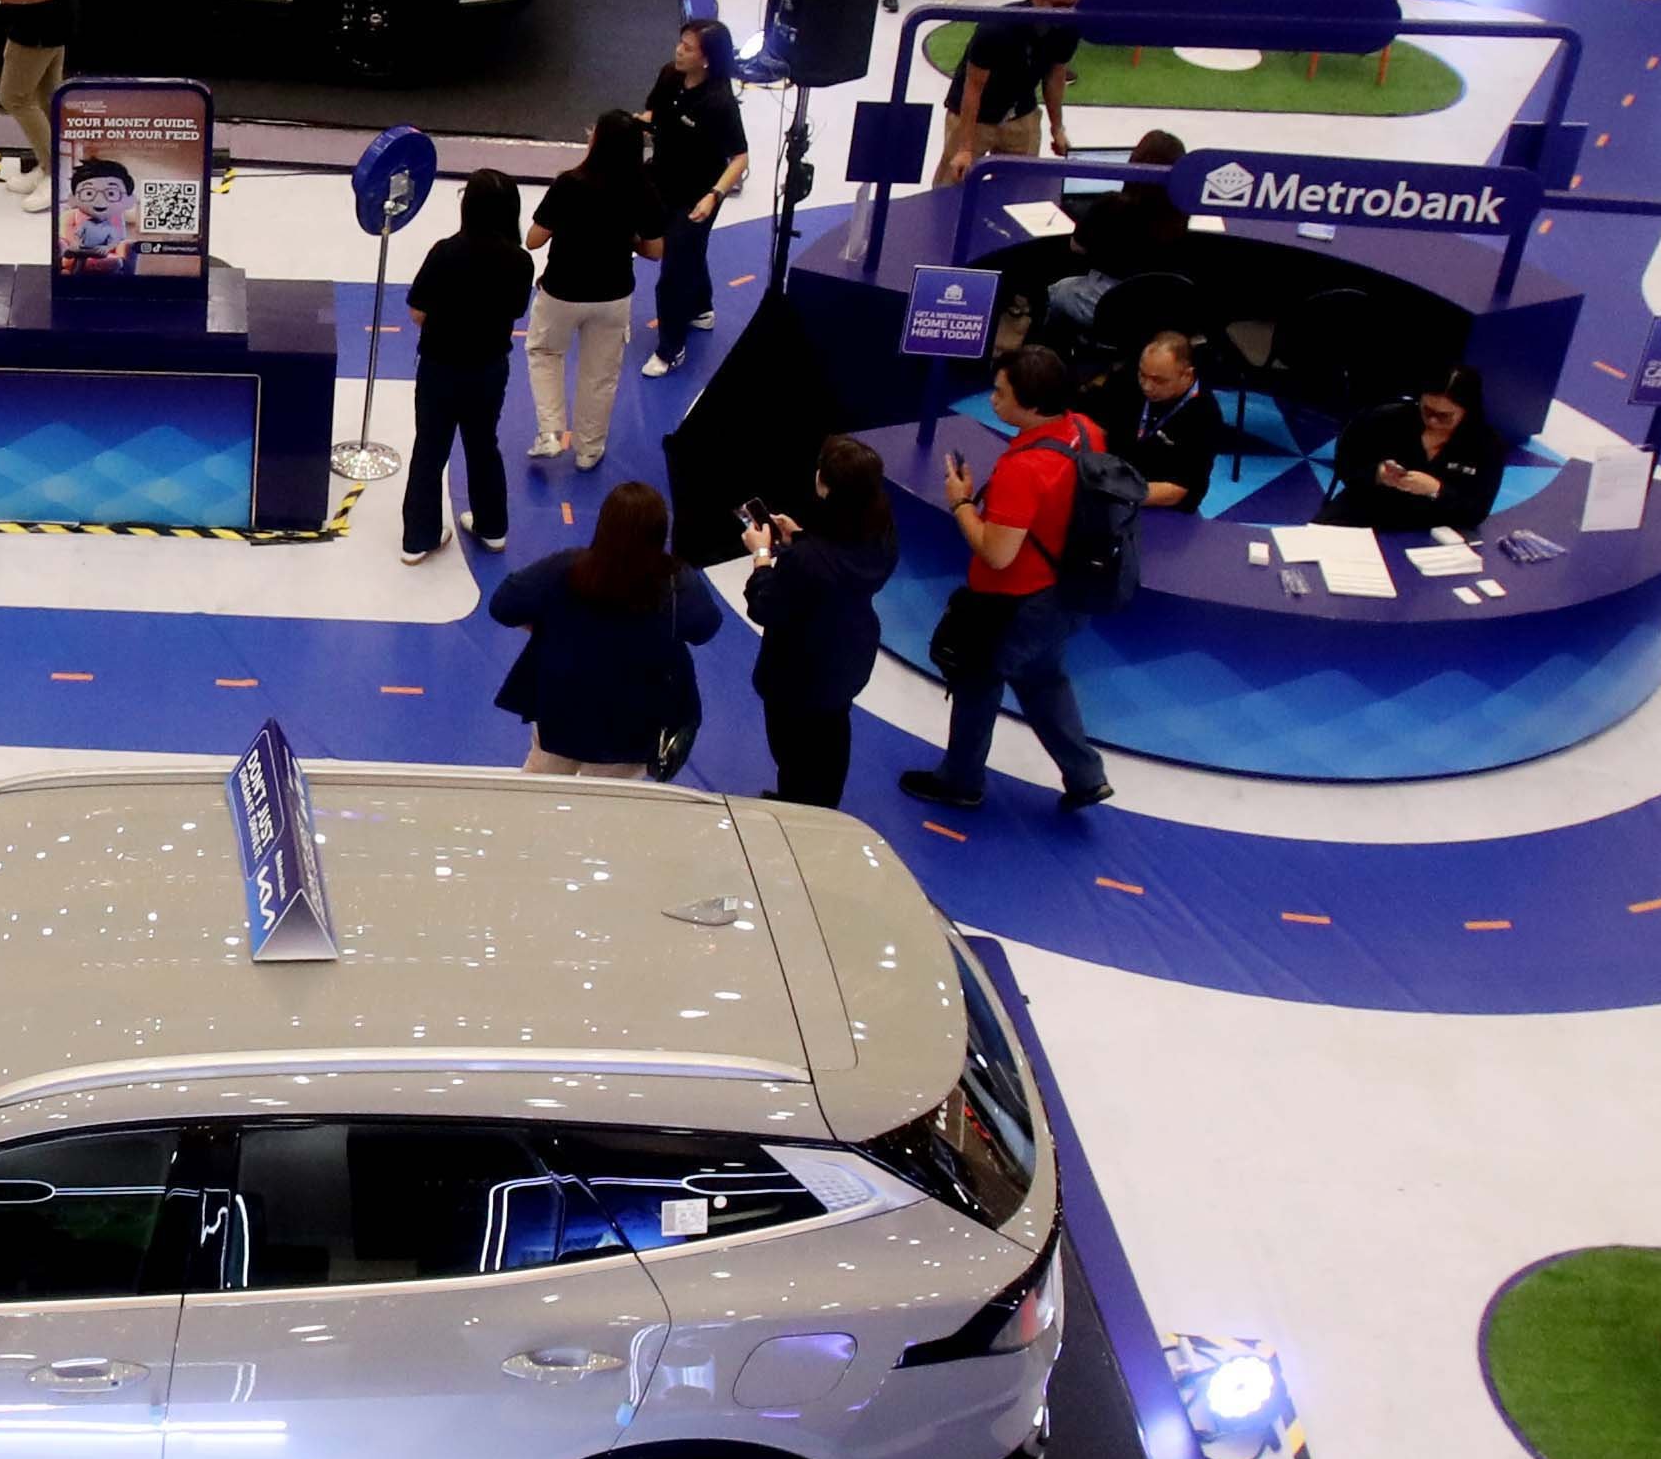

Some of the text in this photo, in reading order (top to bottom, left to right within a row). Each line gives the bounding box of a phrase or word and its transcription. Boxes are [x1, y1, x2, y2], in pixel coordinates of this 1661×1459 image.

[67, 118, 197, 130] YOUR MONEY GUIDE,
[64, 129, 200, 141] RIGHT ON YOUR FEED
[1254, 172, 1505, 225] Metrobank
[913, 318, 982, 332] HOME LOAN
[911, 328, 981, 341] HERE TODAY!
[247, 748, 274, 847] DON'T JUST
